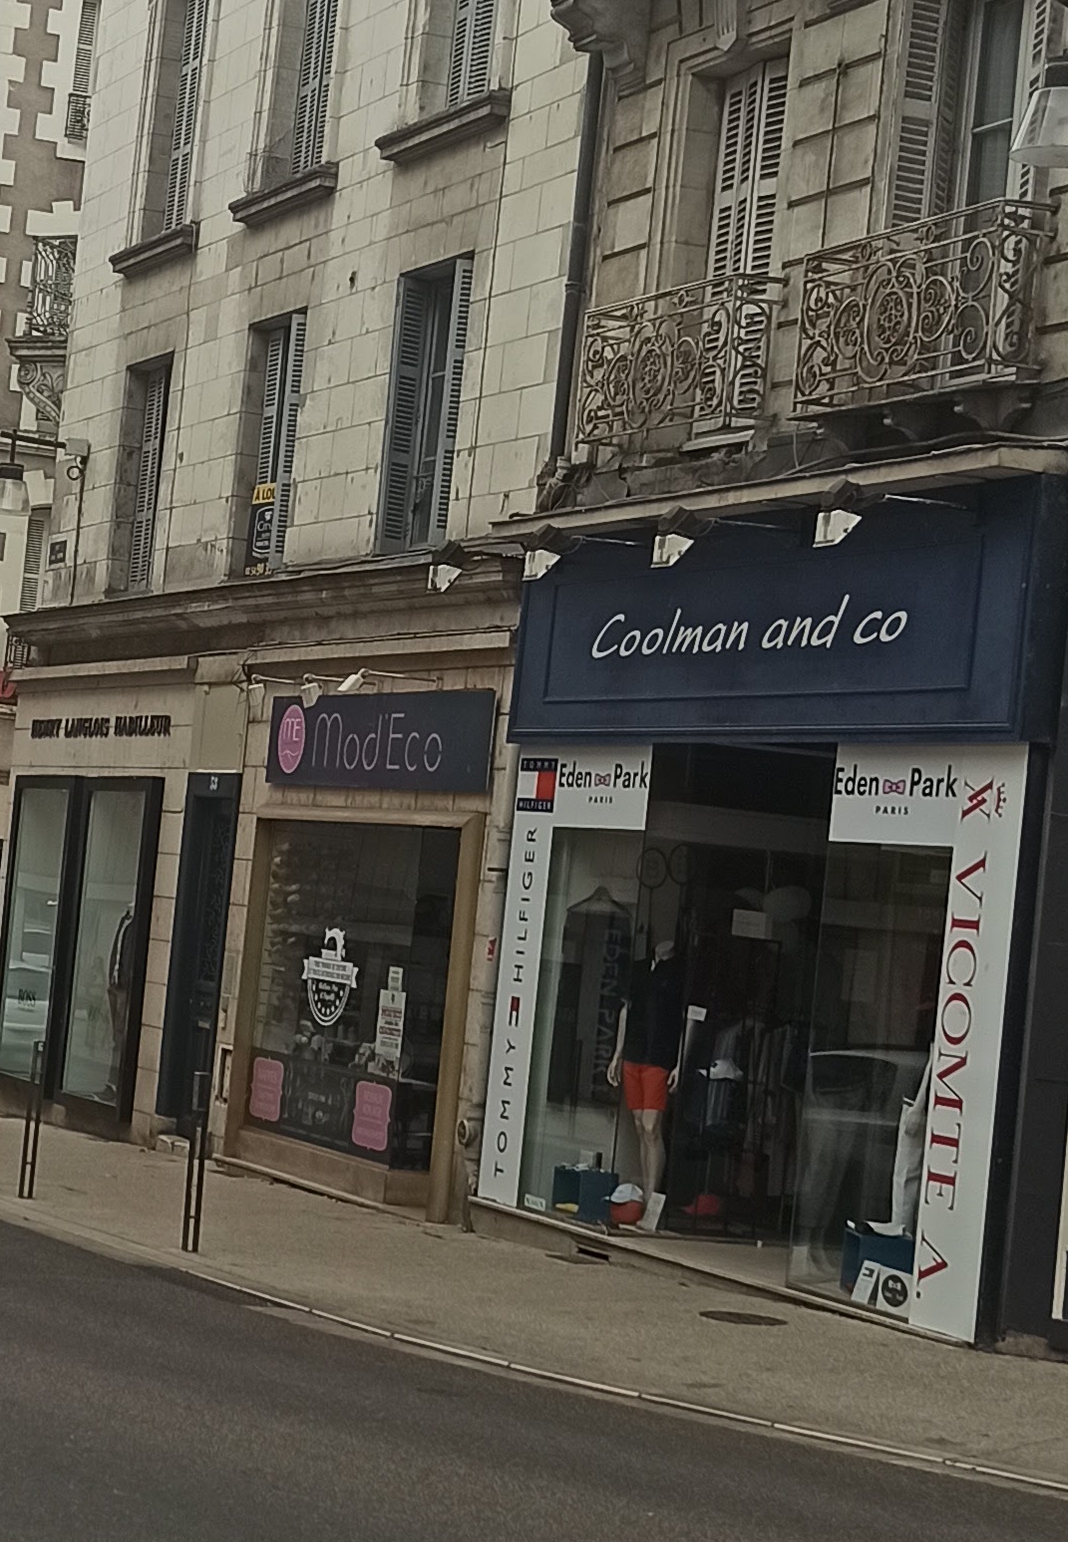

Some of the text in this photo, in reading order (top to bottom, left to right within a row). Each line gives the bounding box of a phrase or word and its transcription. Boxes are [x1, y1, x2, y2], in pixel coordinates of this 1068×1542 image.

[591, 594, 908, 659] Coolman and co
[523, 760, 556, 770] TOMMY
[558, 760, 649, 789] Eden Park
[834, 763, 959, 798] Eden Park
[518, 800, 552, 811] HILFIGER
[588, 796, 614, 804] PARIS
[875, 805, 909, 816] PARIS
[494, 827, 537, 1178] TOMMY HILFIGER
[924, 850, 989, 1212] VICOMTE
